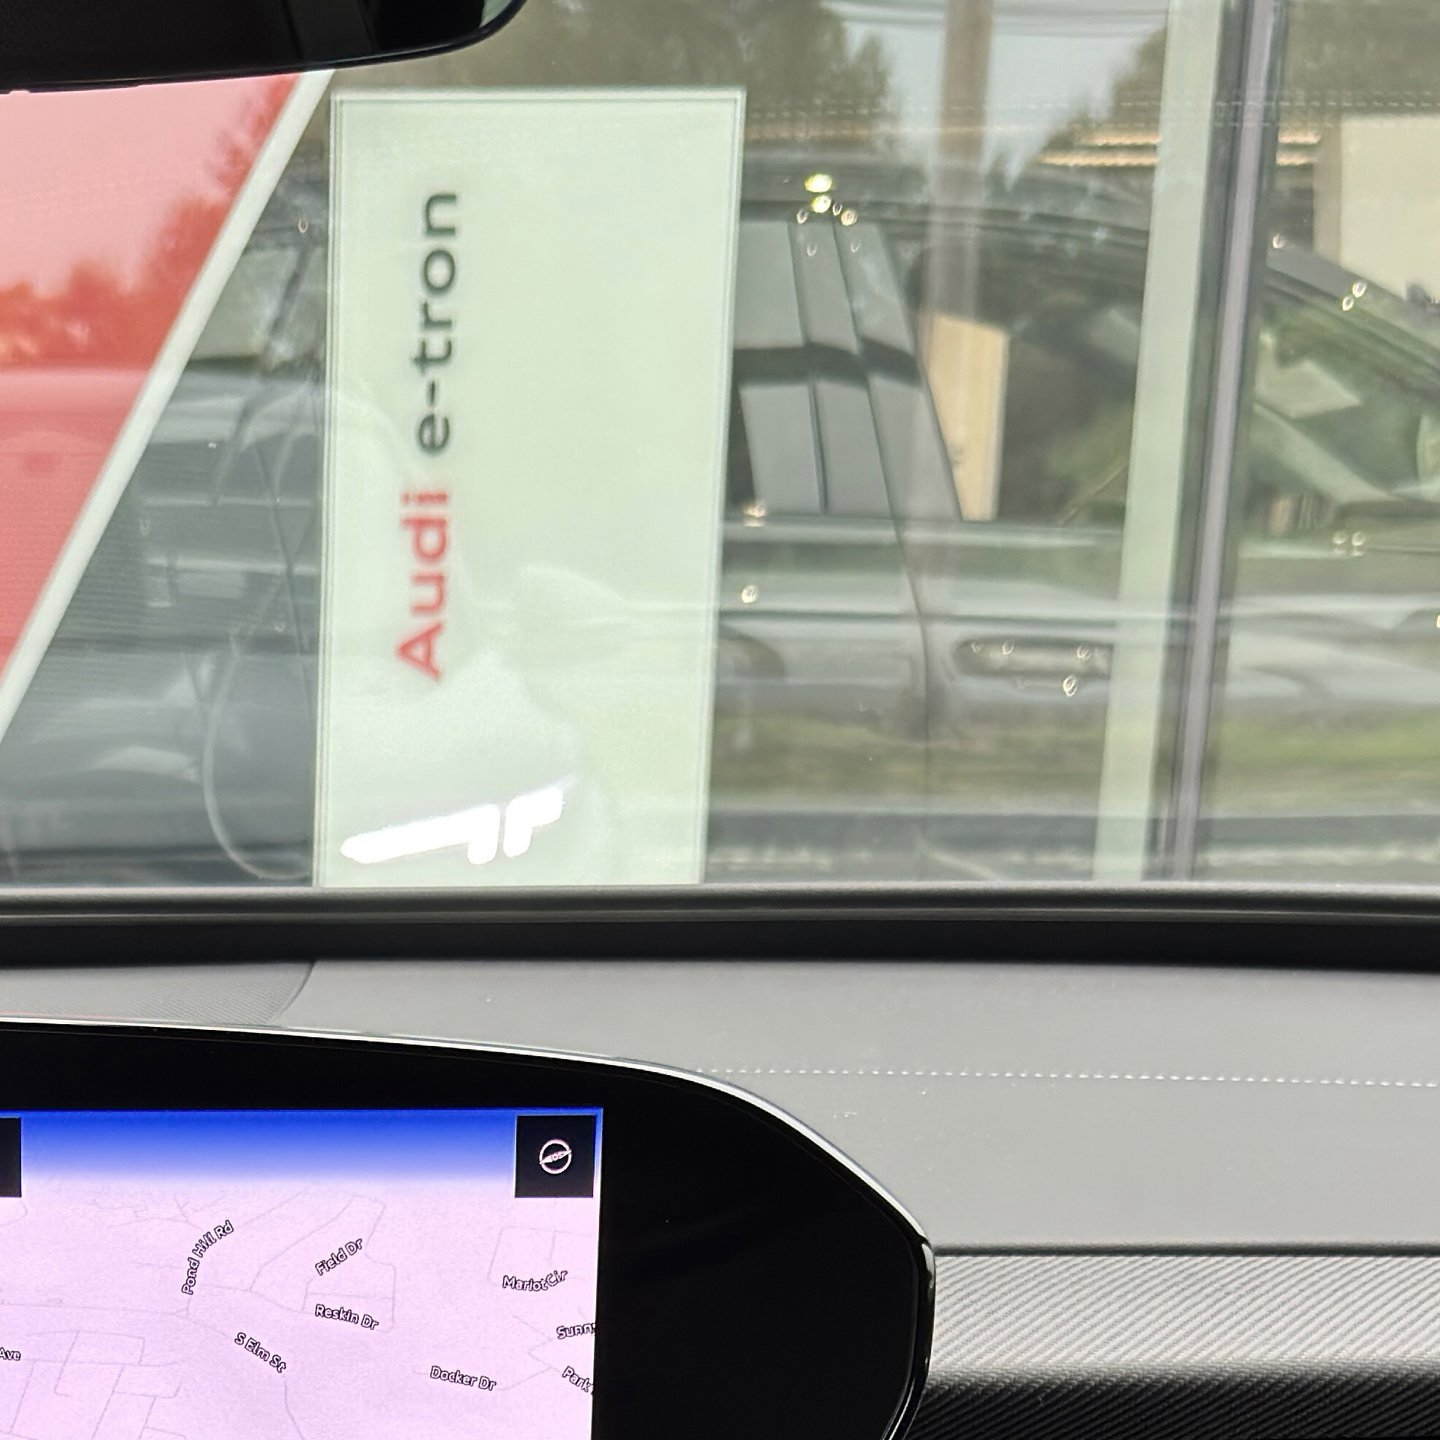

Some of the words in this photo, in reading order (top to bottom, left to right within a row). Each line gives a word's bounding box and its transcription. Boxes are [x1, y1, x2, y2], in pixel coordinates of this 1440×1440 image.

[411, 190, 458, 457] e-tron
[395, 489, 450, 682] Audi
[181, 1257, 200, 1296] Pond
[192, 1232, 217, 1257] Hill
[214, 1220, 234, 1239] Rd
[315, 1248, 347, 1276] Field
[344, 1238, 363, 1257] Dr
[361, 1314, 379, 1330] Dr
[234, 1332, 247, 1345] S
[244, 1337, 270, 1362] Elm
[268, 1354, 287, 1373] St
[430, 1365, 478, 1387] Docker
[478, 1375, 497, 1391] Dr
